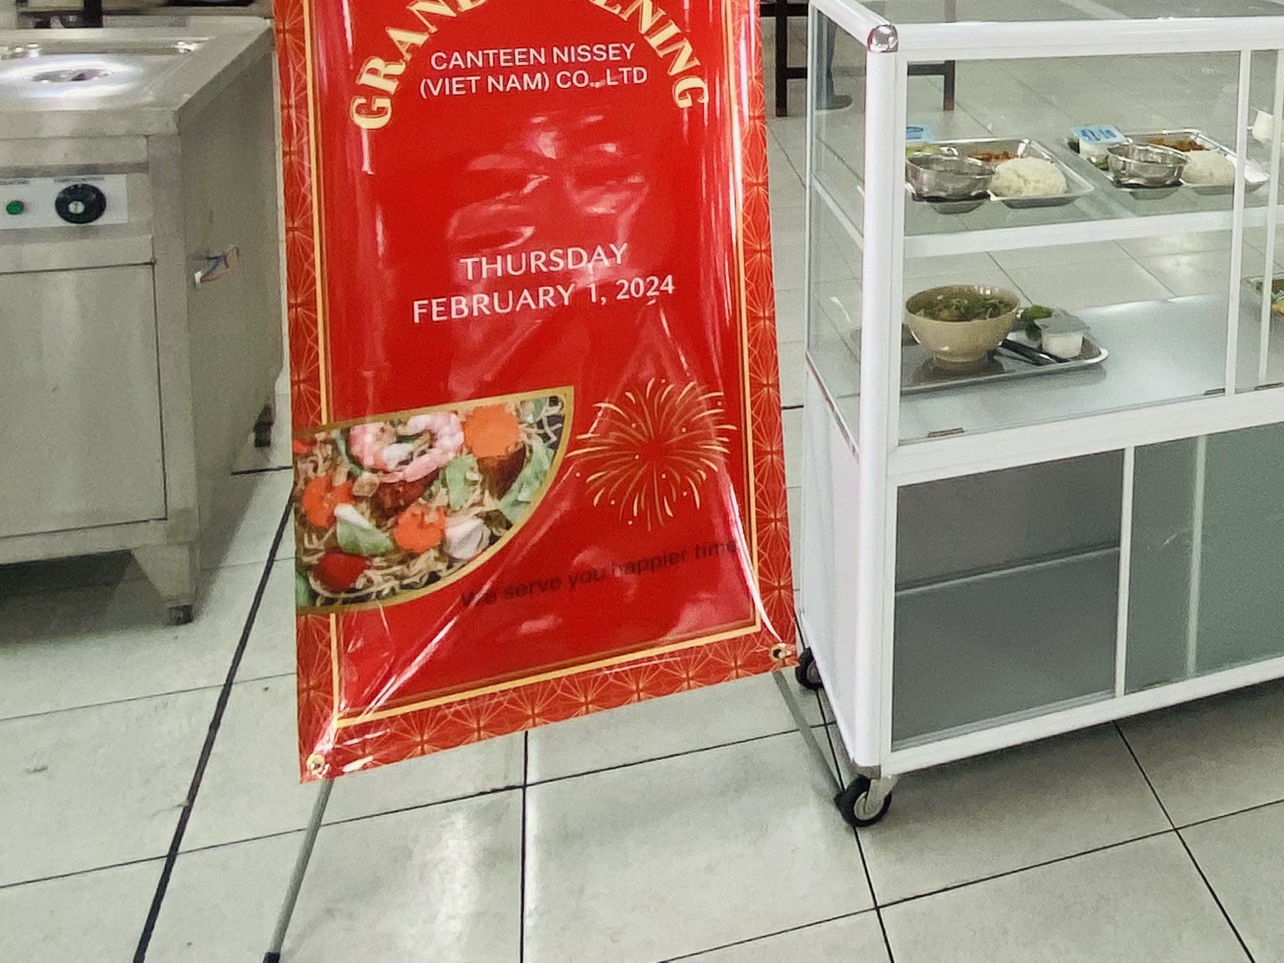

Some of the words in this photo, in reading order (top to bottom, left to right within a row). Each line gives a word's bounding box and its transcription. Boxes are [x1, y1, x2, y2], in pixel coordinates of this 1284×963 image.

[430, 46, 546, 71] CANTEEN
[552, 42, 635, 65] NISSEY
[419, 75, 480, 99] (VIET
[487, 74, 550, 93] NAM)
[556, 69, 600, 89] CO.,
[606, 66, 648, 85] LTD
[459, 243, 628, 280] THURSDAY
[413, 283, 575, 323] FEBRUARY
[587, 282, 606, 306] 1,
[616, 275, 676, 300] 2024
[503, 576, 562, 600] serve
[568, 566, 606, 589] you
[612, 548, 688, 578] happier
